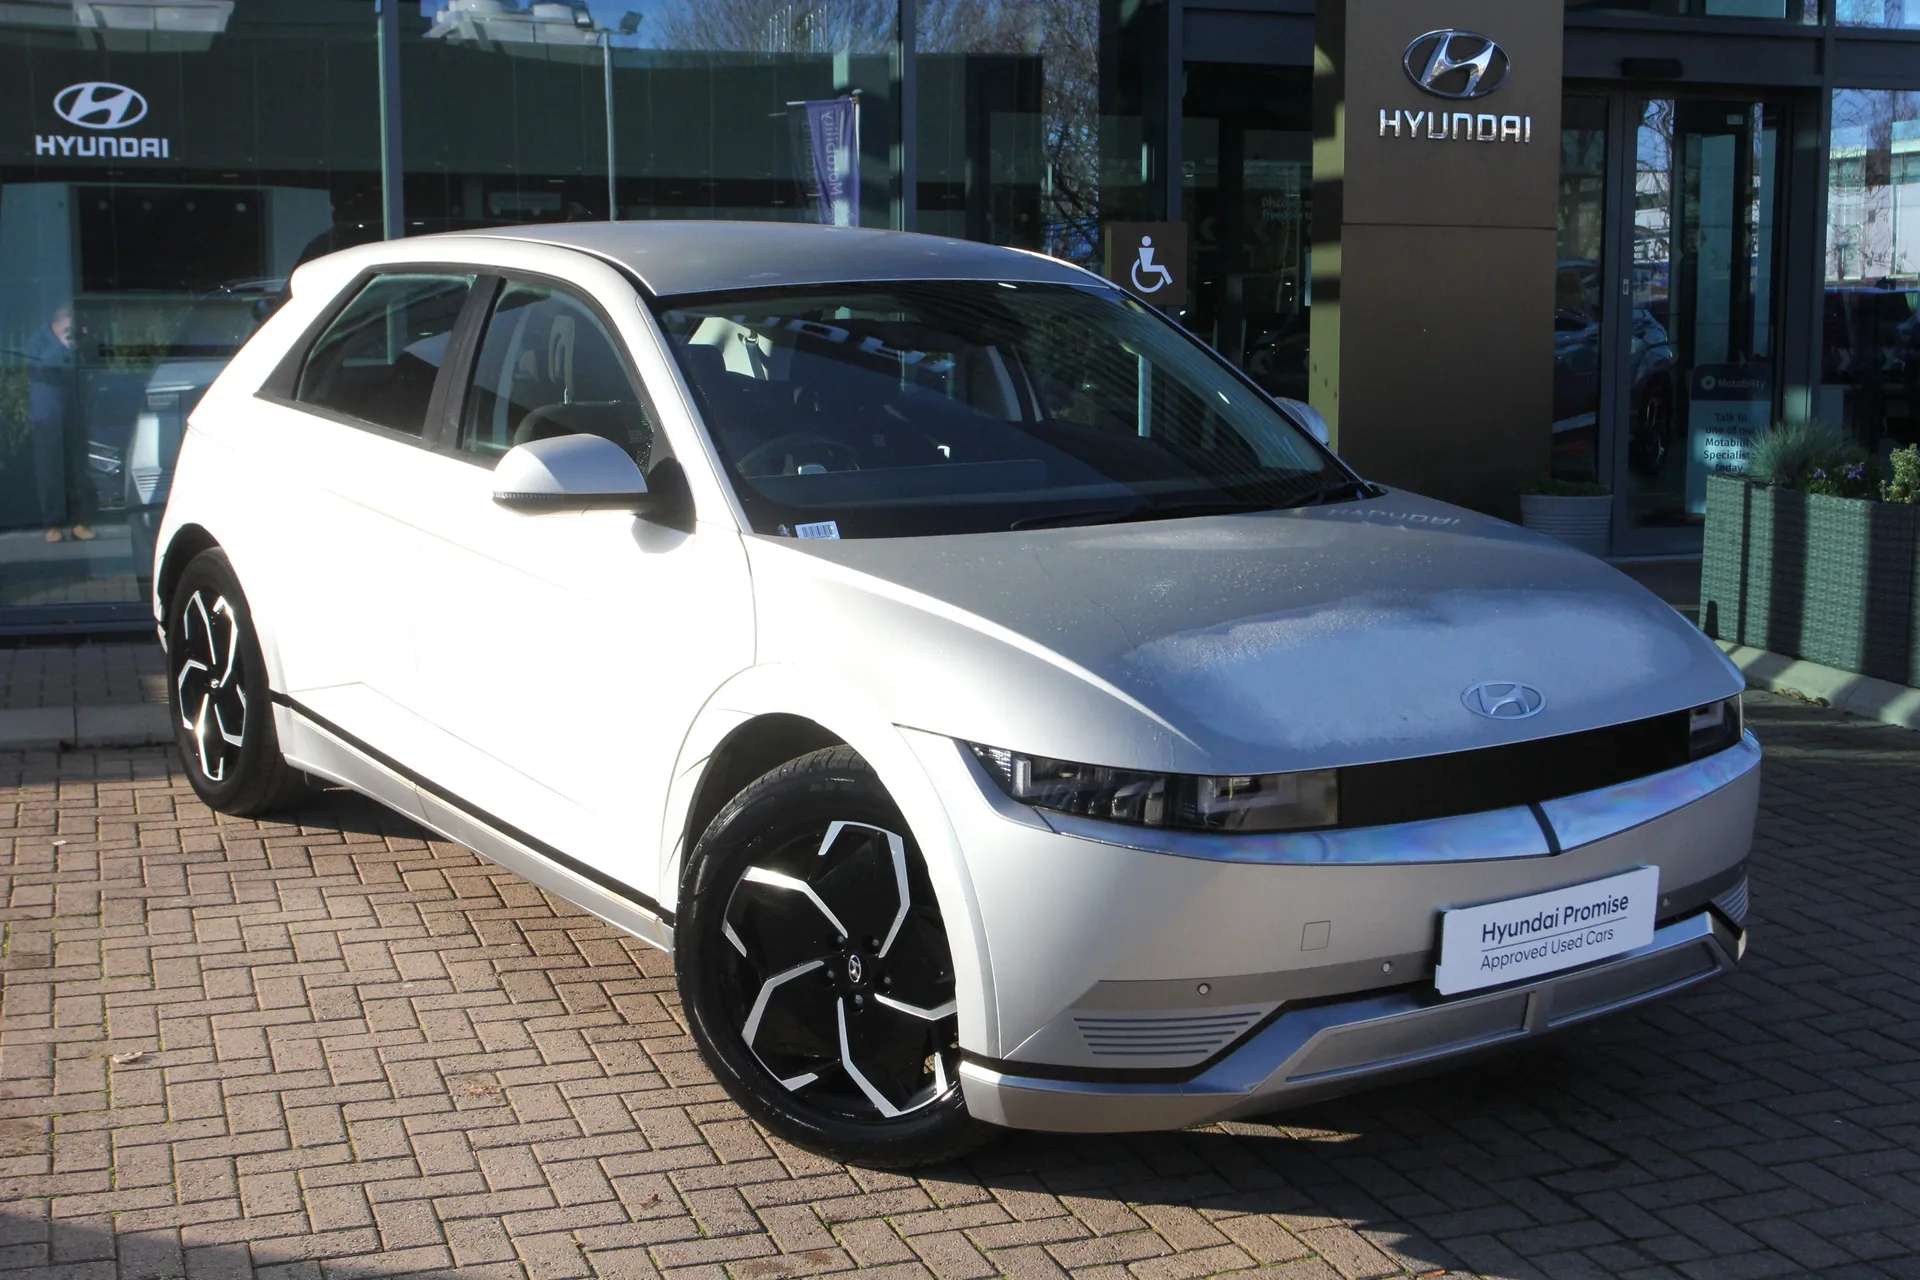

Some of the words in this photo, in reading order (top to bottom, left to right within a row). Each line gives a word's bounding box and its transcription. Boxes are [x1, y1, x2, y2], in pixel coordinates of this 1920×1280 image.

[1379, 109, 1531, 143] HYUNDAI
[35, 135, 169, 158] HYUNDAI
[1705, 438, 1755, 449] Motabilit
[1482, 908, 1559, 944] Hyundai
[1563, 895, 1629, 925] Promise
[1480, 943, 1548, 971] Approved
[1551, 933, 1583, 954] Used
[1586, 928, 1614, 946] Cars
